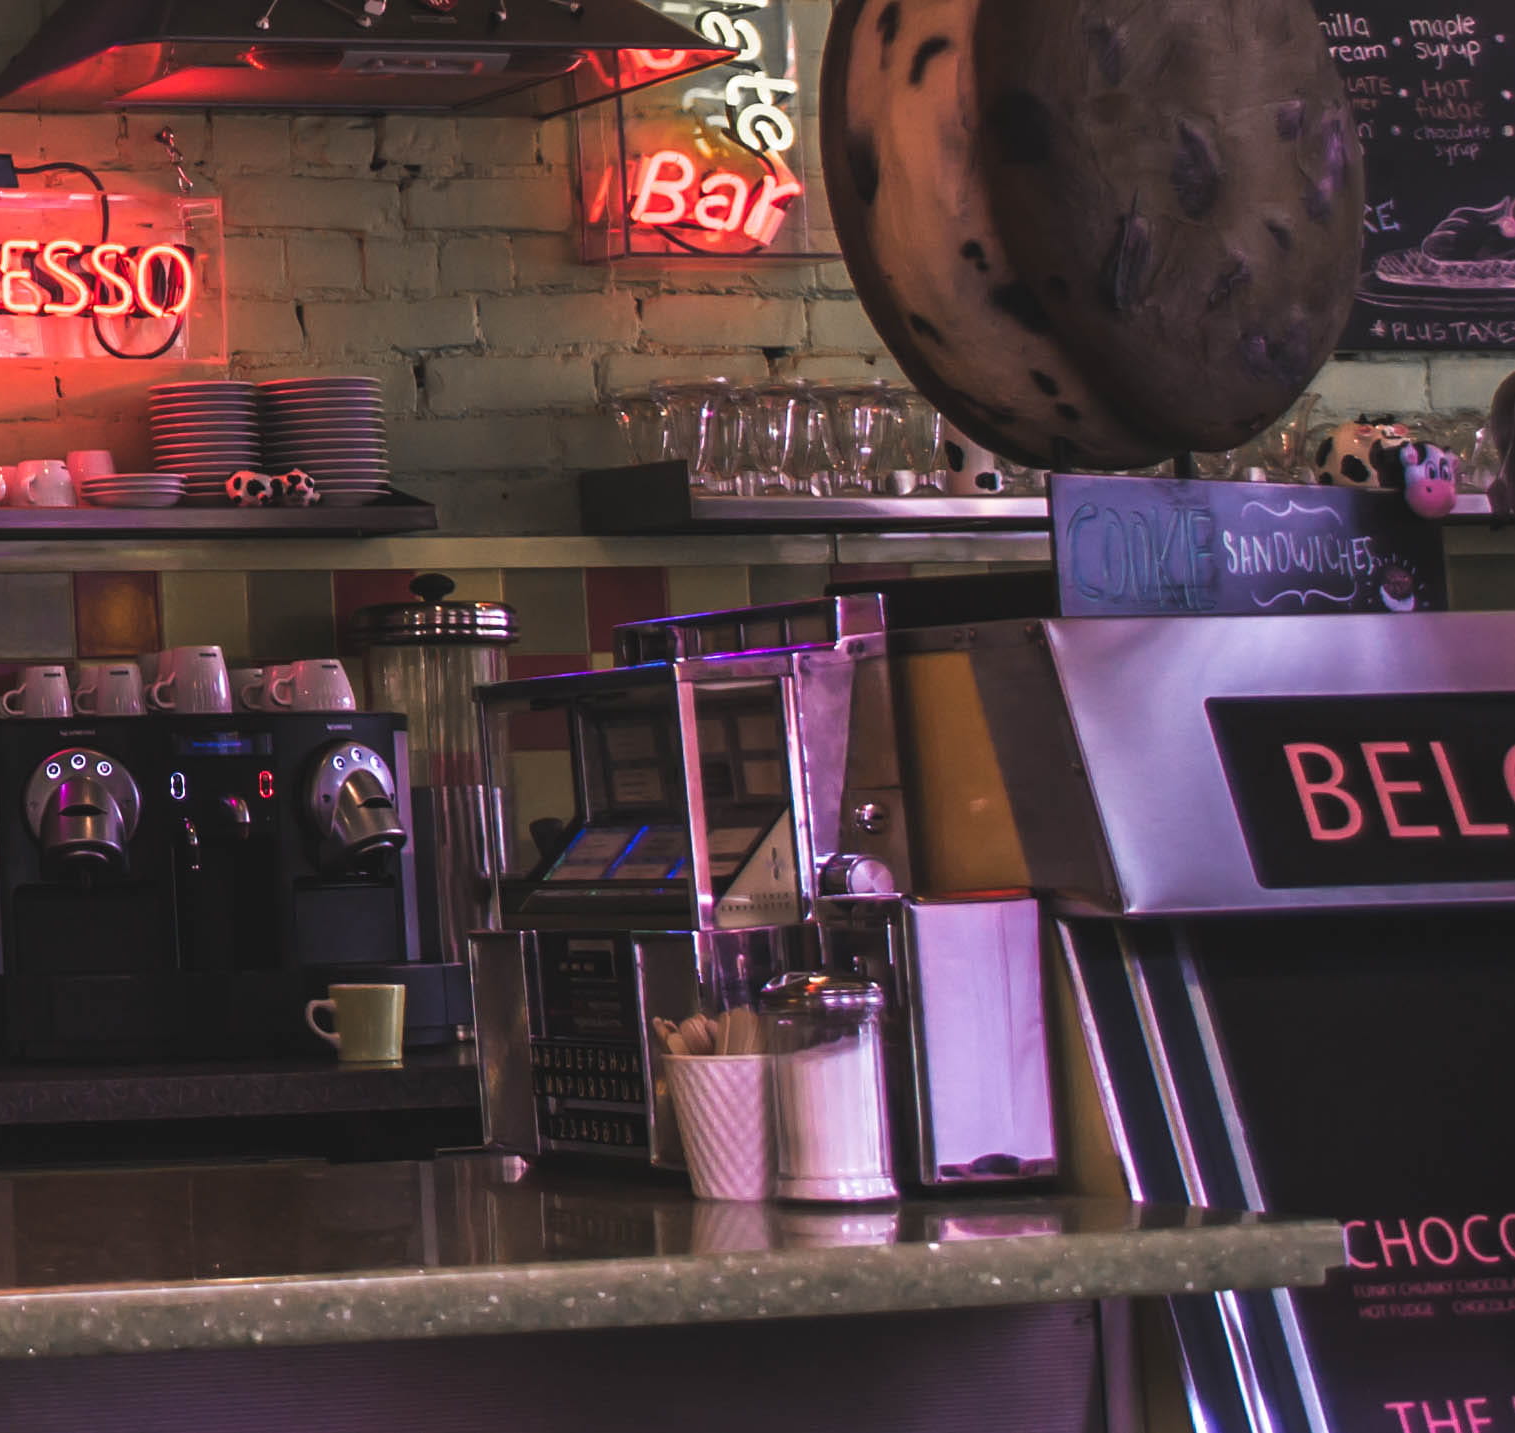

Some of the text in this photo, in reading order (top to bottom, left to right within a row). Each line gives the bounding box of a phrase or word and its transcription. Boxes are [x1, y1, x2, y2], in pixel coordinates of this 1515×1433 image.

[1409, 13, 1476, 42] maple
[1413, 40, 1481, 71] syrup
[1421, 78, 1472, 99] HOT
[632, 149, 802, 248] Bar
[1449, 319, 1515, 344] TAXE
[1067, 502, 1376, 611] COOKIE SANDWICHES
[1282, 738, 1515, 843] BEL
